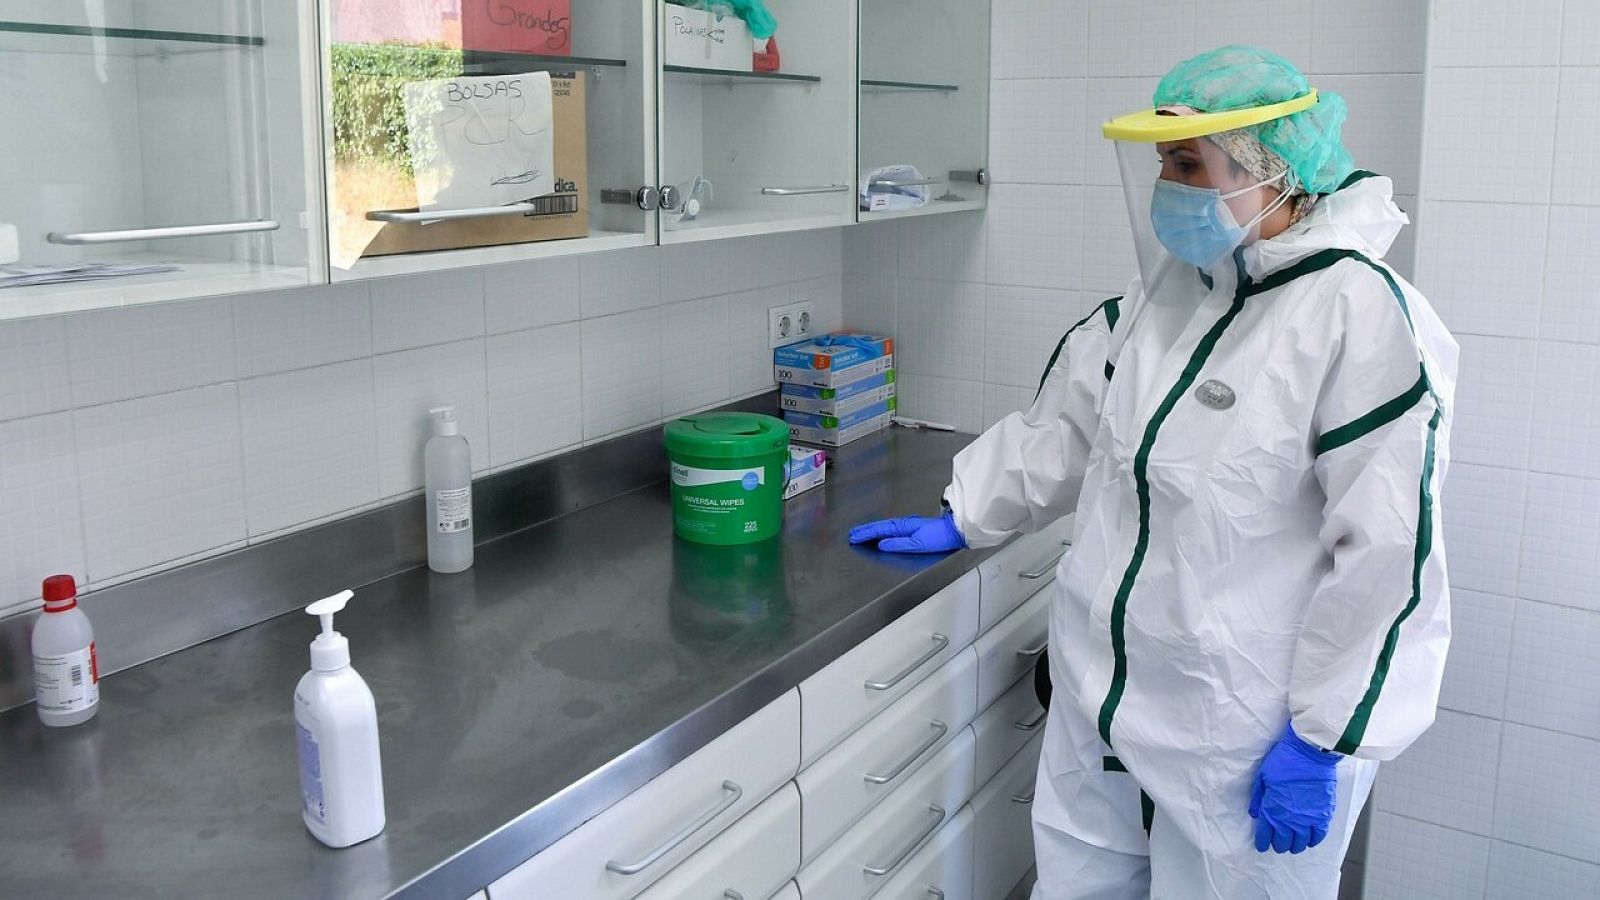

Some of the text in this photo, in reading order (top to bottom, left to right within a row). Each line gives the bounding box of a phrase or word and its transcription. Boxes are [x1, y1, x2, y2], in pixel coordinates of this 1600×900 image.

[447, 79, 522, 102] BOLSAS
[439, 95, 548, 153] PCR
[778, 370, 792, 379] 100
[784, 398, 797, 407] 100
[789, 427, 800, 437] 00
[682, 495, 745, 506] UNIVERSAL WIPES
